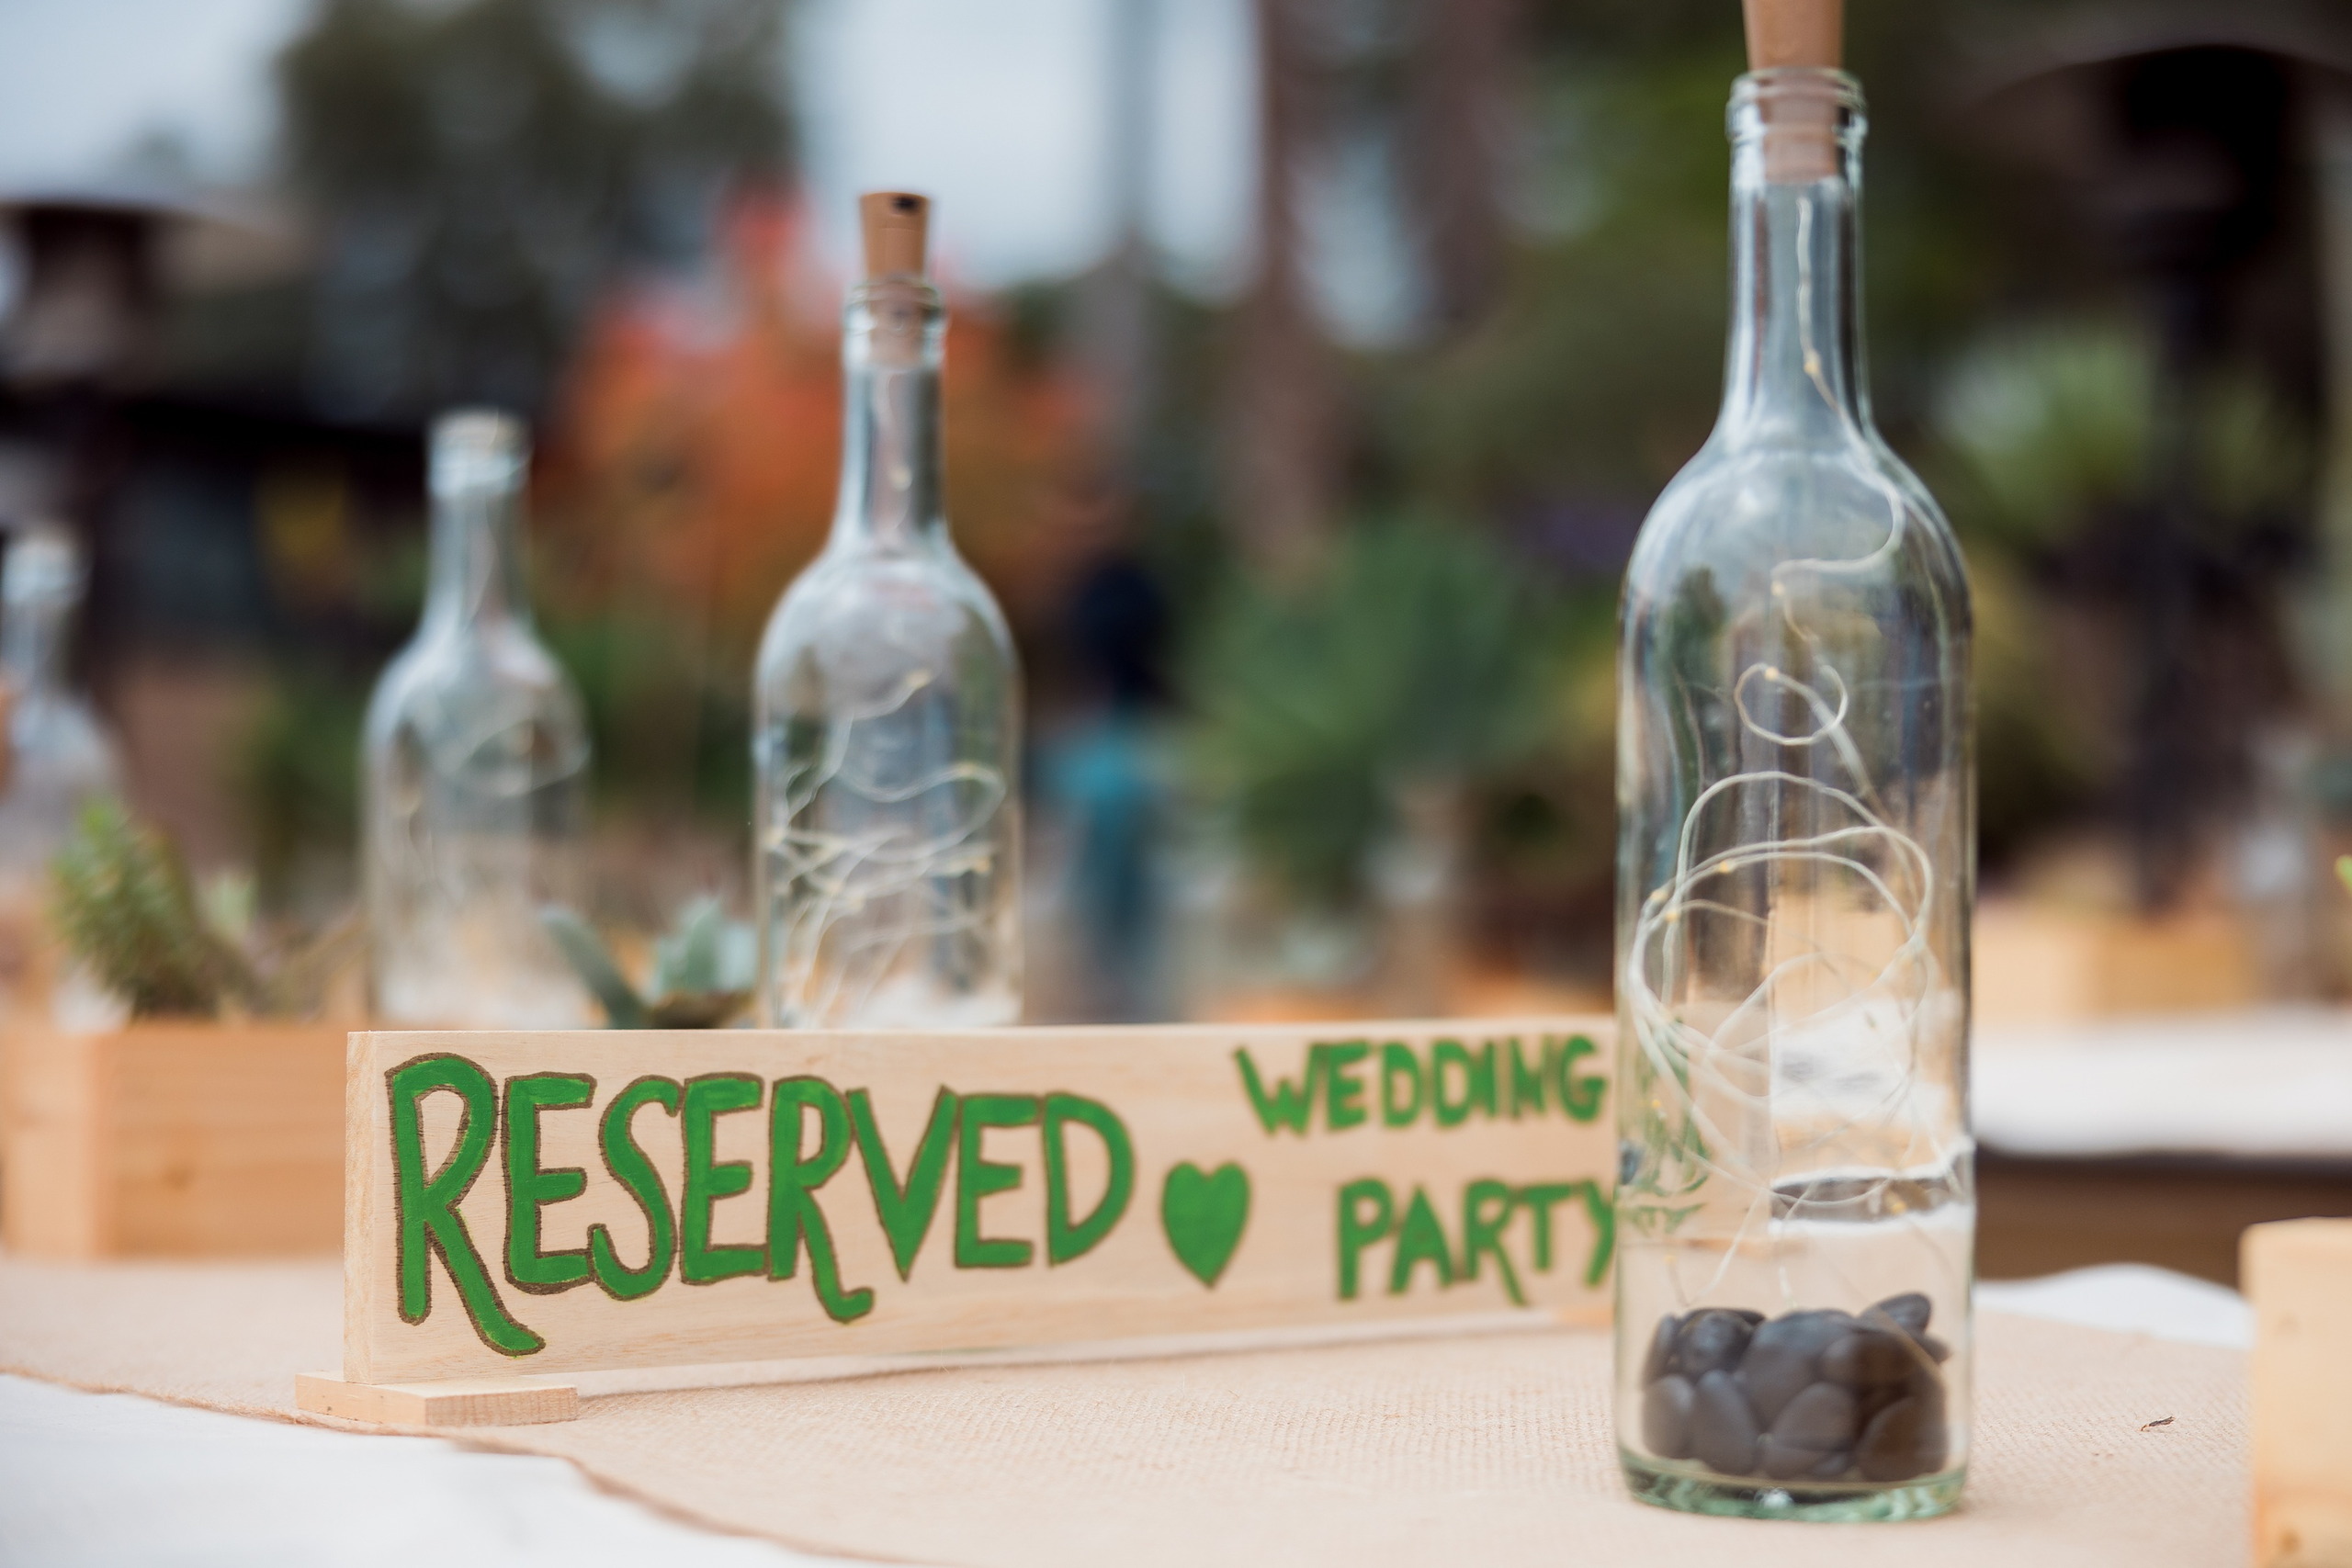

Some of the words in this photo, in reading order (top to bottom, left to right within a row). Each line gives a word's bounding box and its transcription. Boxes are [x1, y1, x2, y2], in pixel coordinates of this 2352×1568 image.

[1234, 1035, 1608, 1136] WEDDING
[385, 1053, 1136, 1356] RESERVED
[1337, 1178, 1615, 1307] PARTY
